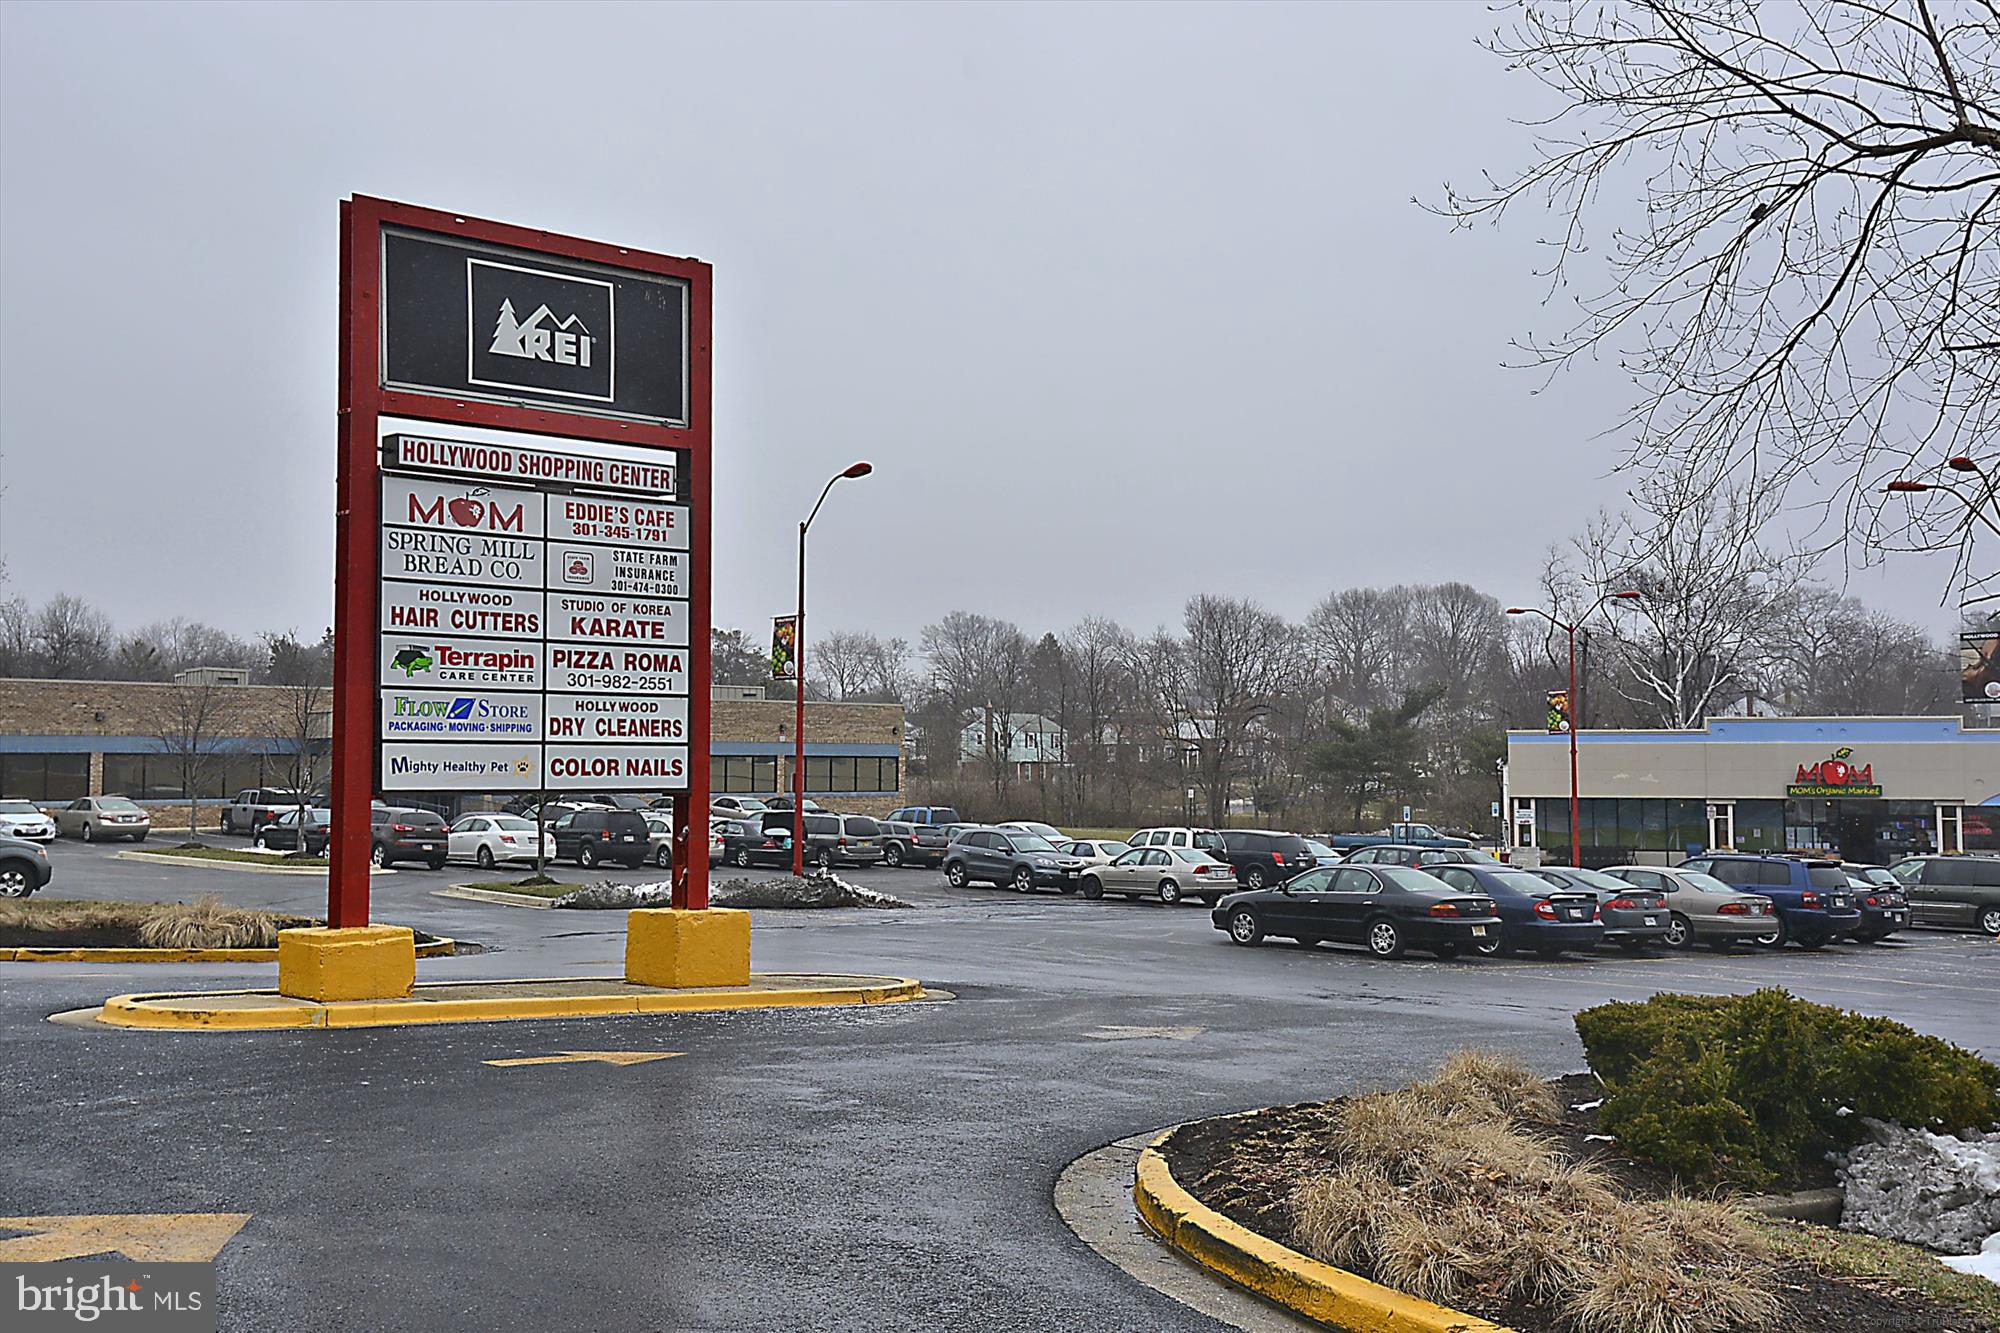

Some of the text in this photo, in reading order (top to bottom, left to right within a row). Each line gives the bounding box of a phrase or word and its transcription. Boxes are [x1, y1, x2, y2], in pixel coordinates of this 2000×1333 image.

[525, 329, 591, 367] REI
[403, 440, 670, 489] HOLLYWOOD SHOPPING CENTER
[565, 502, 675, 528] EDDIE'S CAFE
[572, 522, 667, 542] 301-345-1791
[388, 531, 535, 560] SPRING MILL
[403, 554, 523, 580] BREAD CO.
[612, 550, 678, 566] STATE FARM
[615, 565, 675, 582] INSURANCE
[611, 579, 679, 596] 301-474-0300
[419, 589, 513, 607] HOLLYWOOD
[561, 599, 672, 617] STUDIO OF KOREA
[390, 606, 539, 633] HAIR CUTTERS
[570, 616, 665, 640] KARATE
[434, 645, 535, 672] Terrapin
[552, 649, 683, 673] PIZZA ROMA
[439, 671, 534, 683] CARE CENTER
[567, 672, 673, 691] 301-982-2551
[393, 696, 528, 718] FLOW STORE
[575, 700, 659, 713] HOLLYWOOD
[449, 722, 486, 732] MOVING
[489, 723, 533, 733] SHIPPING
[549, 717, 683, 738] DRY CLEANERS
[391, 756, 509, 775] Mighty Healthy Pet
[550, 758, 683, 776] COLOR NAILS
[1816, 786, 1846, 796] Organic
[1847, 786, 1880, 795] Market
